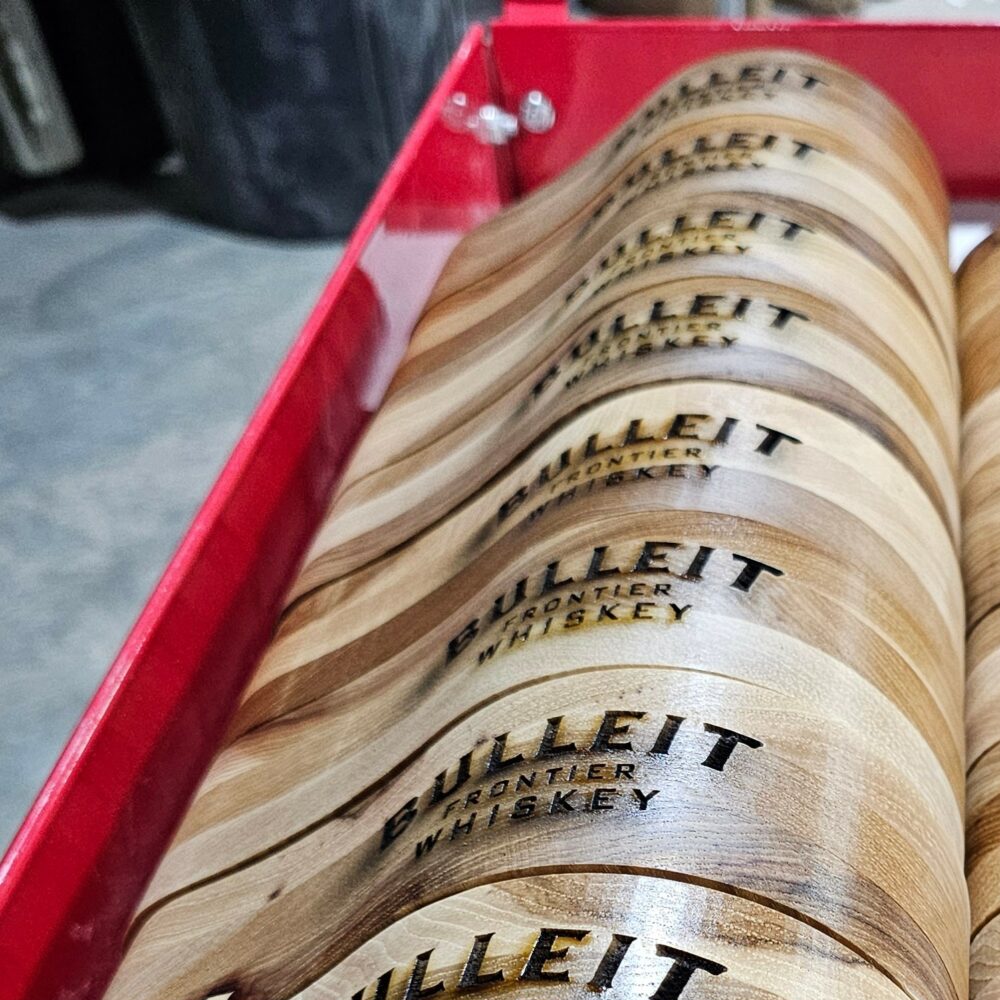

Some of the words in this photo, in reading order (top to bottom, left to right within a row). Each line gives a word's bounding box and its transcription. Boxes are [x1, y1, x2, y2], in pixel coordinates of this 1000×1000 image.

[446, 541, 785, 666] BULLEIT
[478, 601, 692, 666] WHISKEY
[504, 583, 673, 632] FRONTIER
[380, 710, 764, 851] BULLEIT
[443, 763, 636, 819] FRONTIER
[415, 788, 660, 859] WHISKEY
